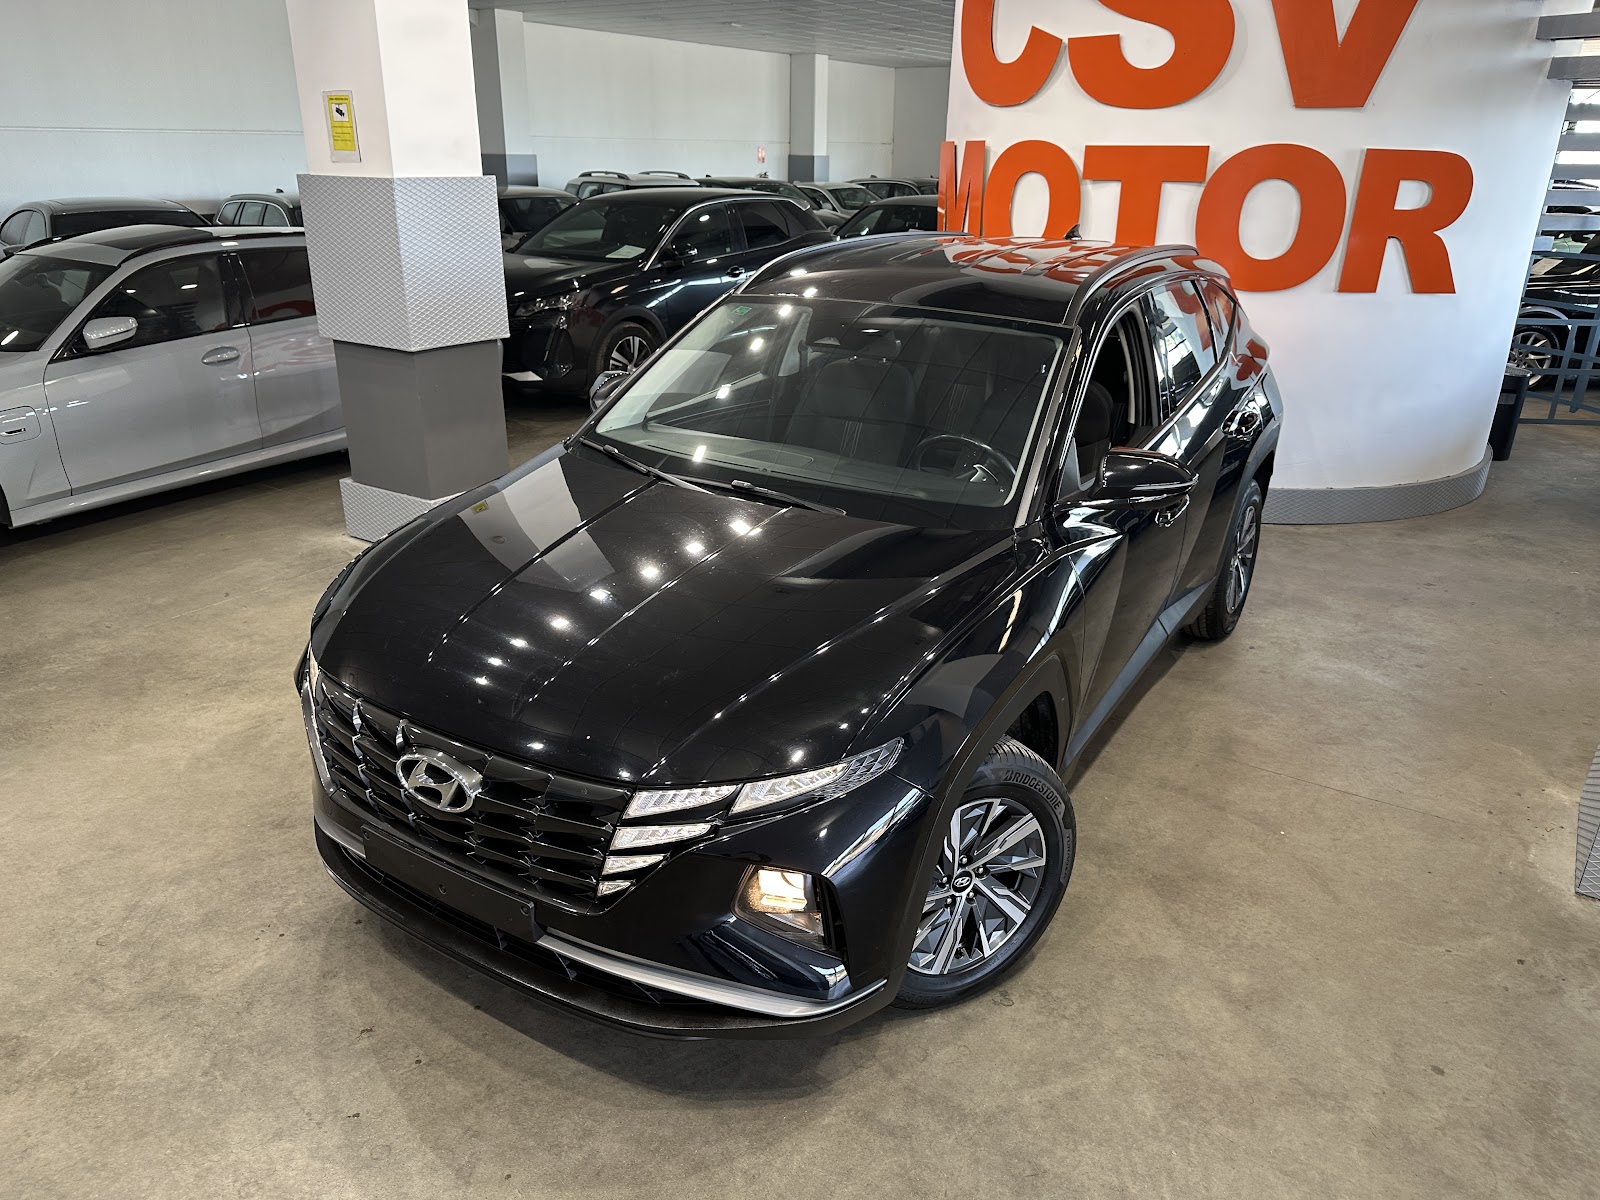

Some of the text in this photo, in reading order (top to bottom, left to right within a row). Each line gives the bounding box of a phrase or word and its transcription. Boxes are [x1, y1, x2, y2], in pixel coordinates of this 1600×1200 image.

[961, 0, 1418, 109] CSV
[937, 140, 1474, 294] MOTOR
[1003, 770, 1062, 810] BRIDGESTONE
